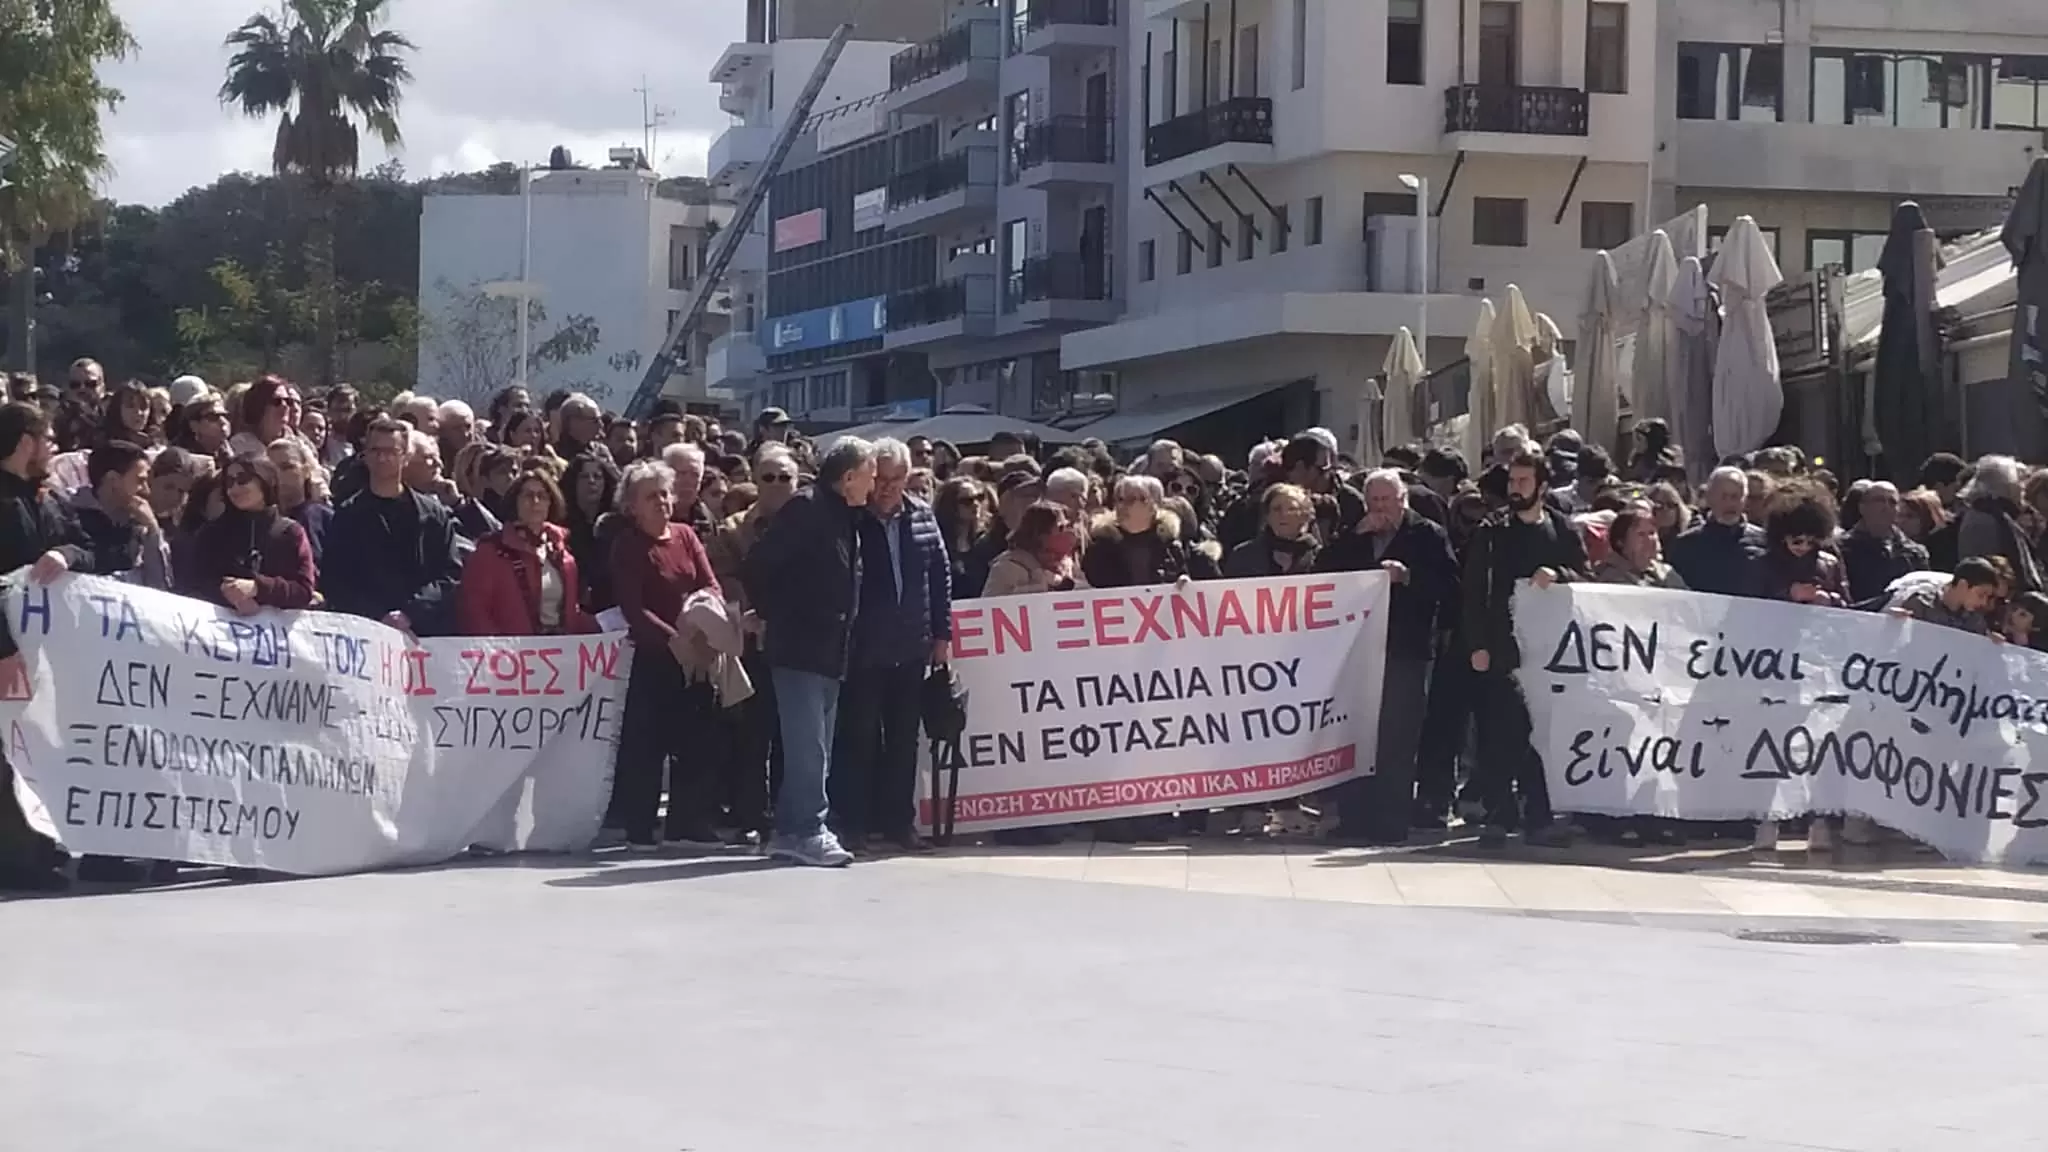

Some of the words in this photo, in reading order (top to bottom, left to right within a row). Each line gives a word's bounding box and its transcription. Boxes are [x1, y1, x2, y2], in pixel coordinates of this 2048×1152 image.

[20, 586, 50, 636] Η
[90, 595, 145, 642] ΤΑ
[177, 612, 291, 669] ΚΕΡΔΗ
[313, 630, 373, 681] ΤΟΥΣ
[401, 649, 437, 696] ΟΙ
[460, 648, 565, 697] ΖΩΕΣ
[951, 605, 1032, 659] ΕΝ
[1543, 619, 1658, 675] ΔΕΝ
[1686, 632, 1806, 680] είναι
[97, 659, 171, 709] ΔΕΝ
[190, 672, 342, 729] ΞΕΧΝΑΜΕ
[1011, 679, 1065, 714] ΤΑ
[1076, 666, 1213, 708] ΠΑΙΔΙΑ
[1221, 657, 1301, 697] ΠΟΥ
[1041, 712, 1231, 760] ΕΦΤΑΣΑΝ
[953, 795, 1025, 819] ΕΝΩΣΗ
[1031, 777, 1197, 812] ΣΥΝΤΑΞΙΟΥΧΩΝ
[1202, 774, 1241, 794] ΙΚΑ
[1242, 772, 1264, 789] Ν.
[1565, 727, 1706, 786] είναι
[1740, 725, 2048, 829] ΔΟΛΟΦΟΝΙΕΣ
[66, 785, 300, 841] ΕΠΙΣΙΤΙΣΜΟΥ
